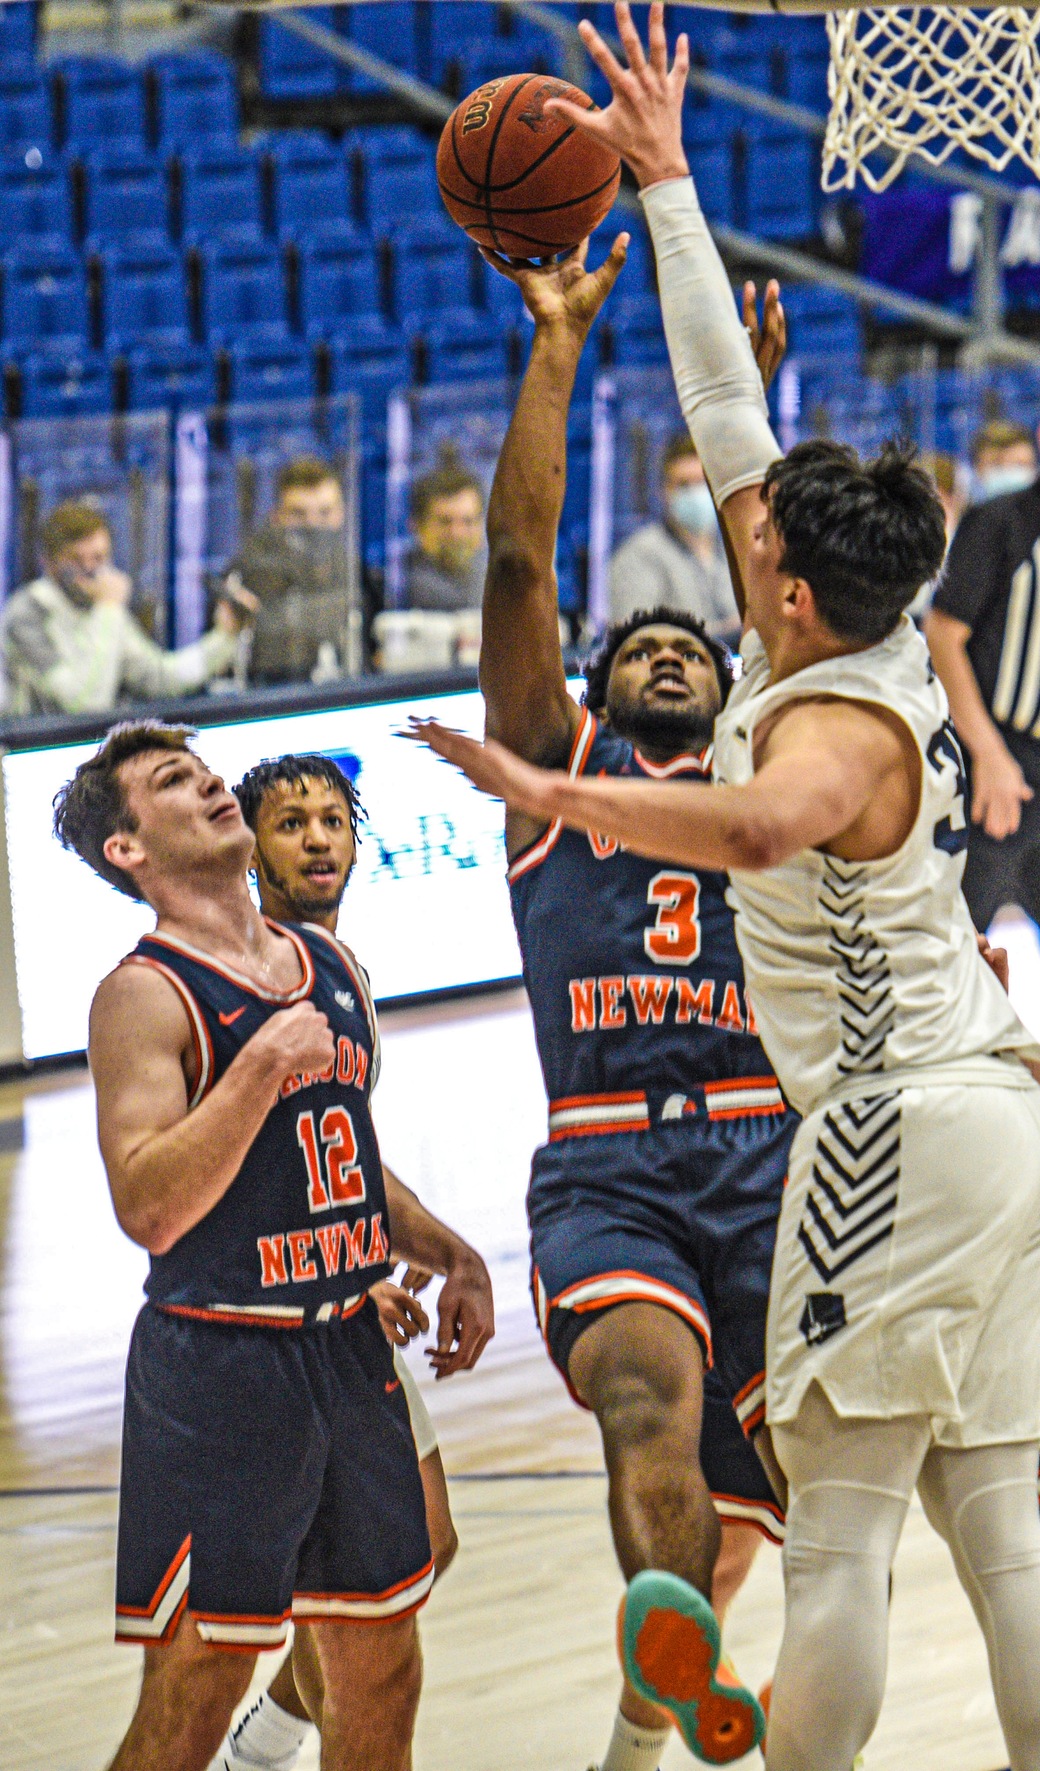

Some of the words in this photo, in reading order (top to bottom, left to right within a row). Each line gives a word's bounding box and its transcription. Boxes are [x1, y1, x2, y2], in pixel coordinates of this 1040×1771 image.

[644, 869, 701, 966] 3
[296, 1104, 366, 1214] 12
[257, 1212, 389, 1288] NEWMA
